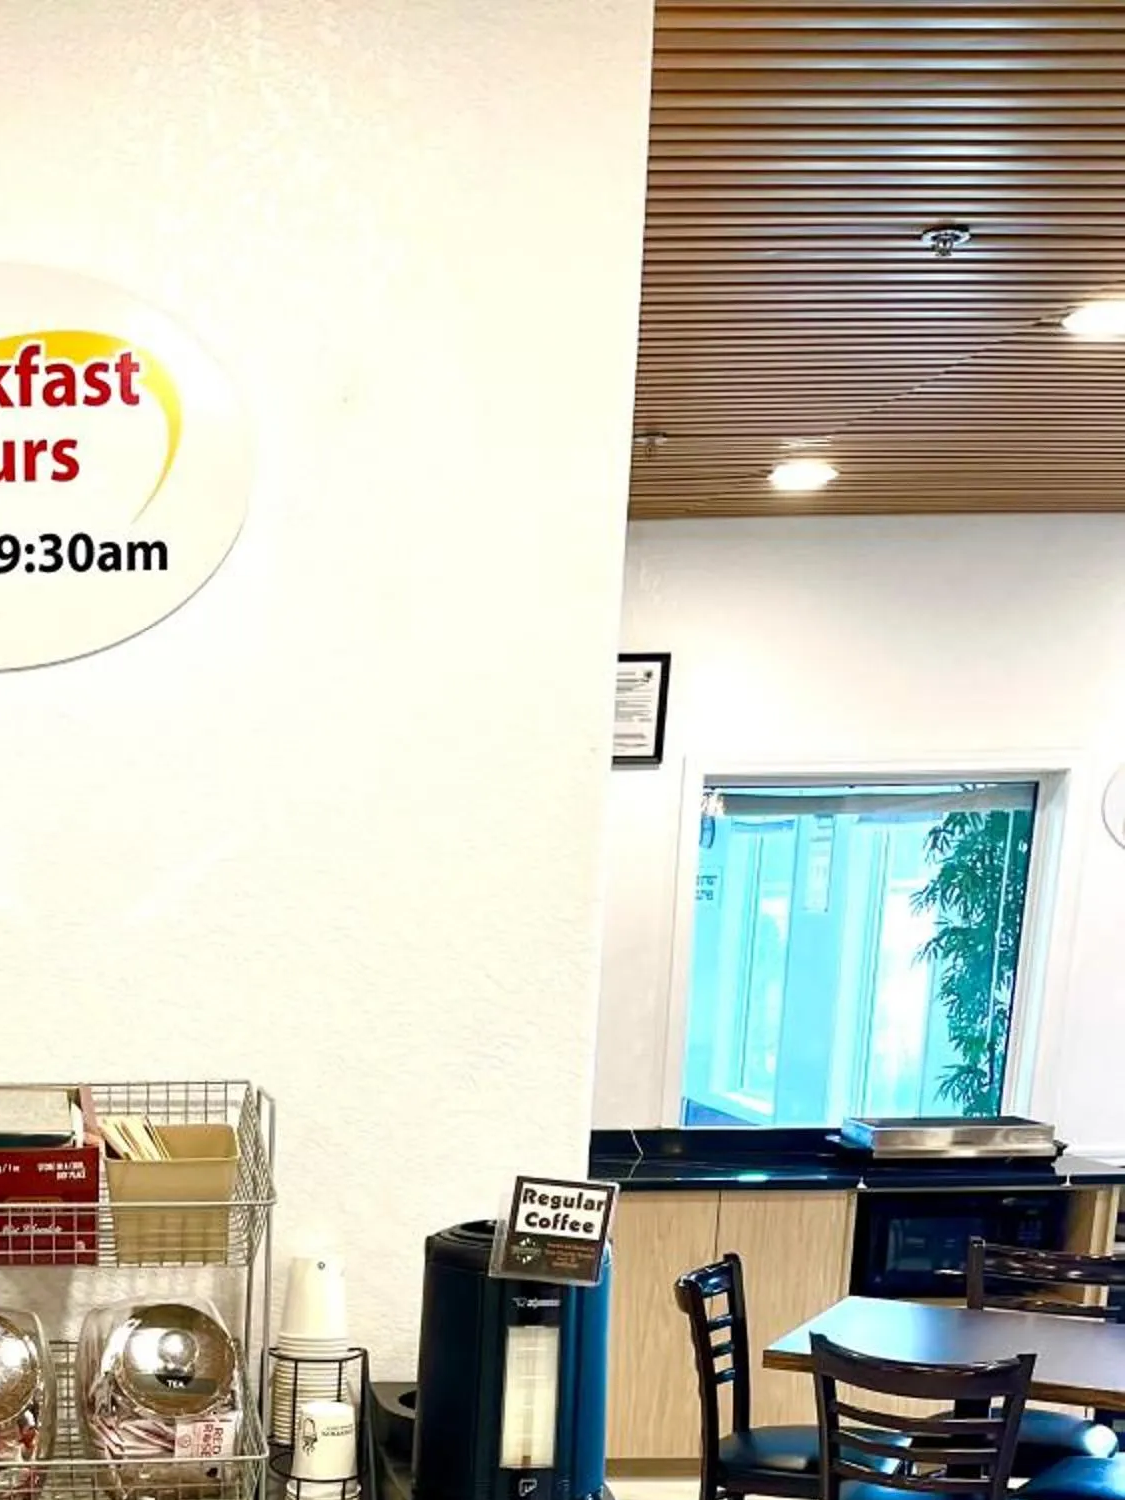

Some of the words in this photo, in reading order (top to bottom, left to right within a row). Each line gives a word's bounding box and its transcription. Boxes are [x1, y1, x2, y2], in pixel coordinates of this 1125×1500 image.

[522, 1187, 605, 1212] Regular
[524, 1211, 595, 1234] Coffee
[166, 1379, 186, 1389] TEA
